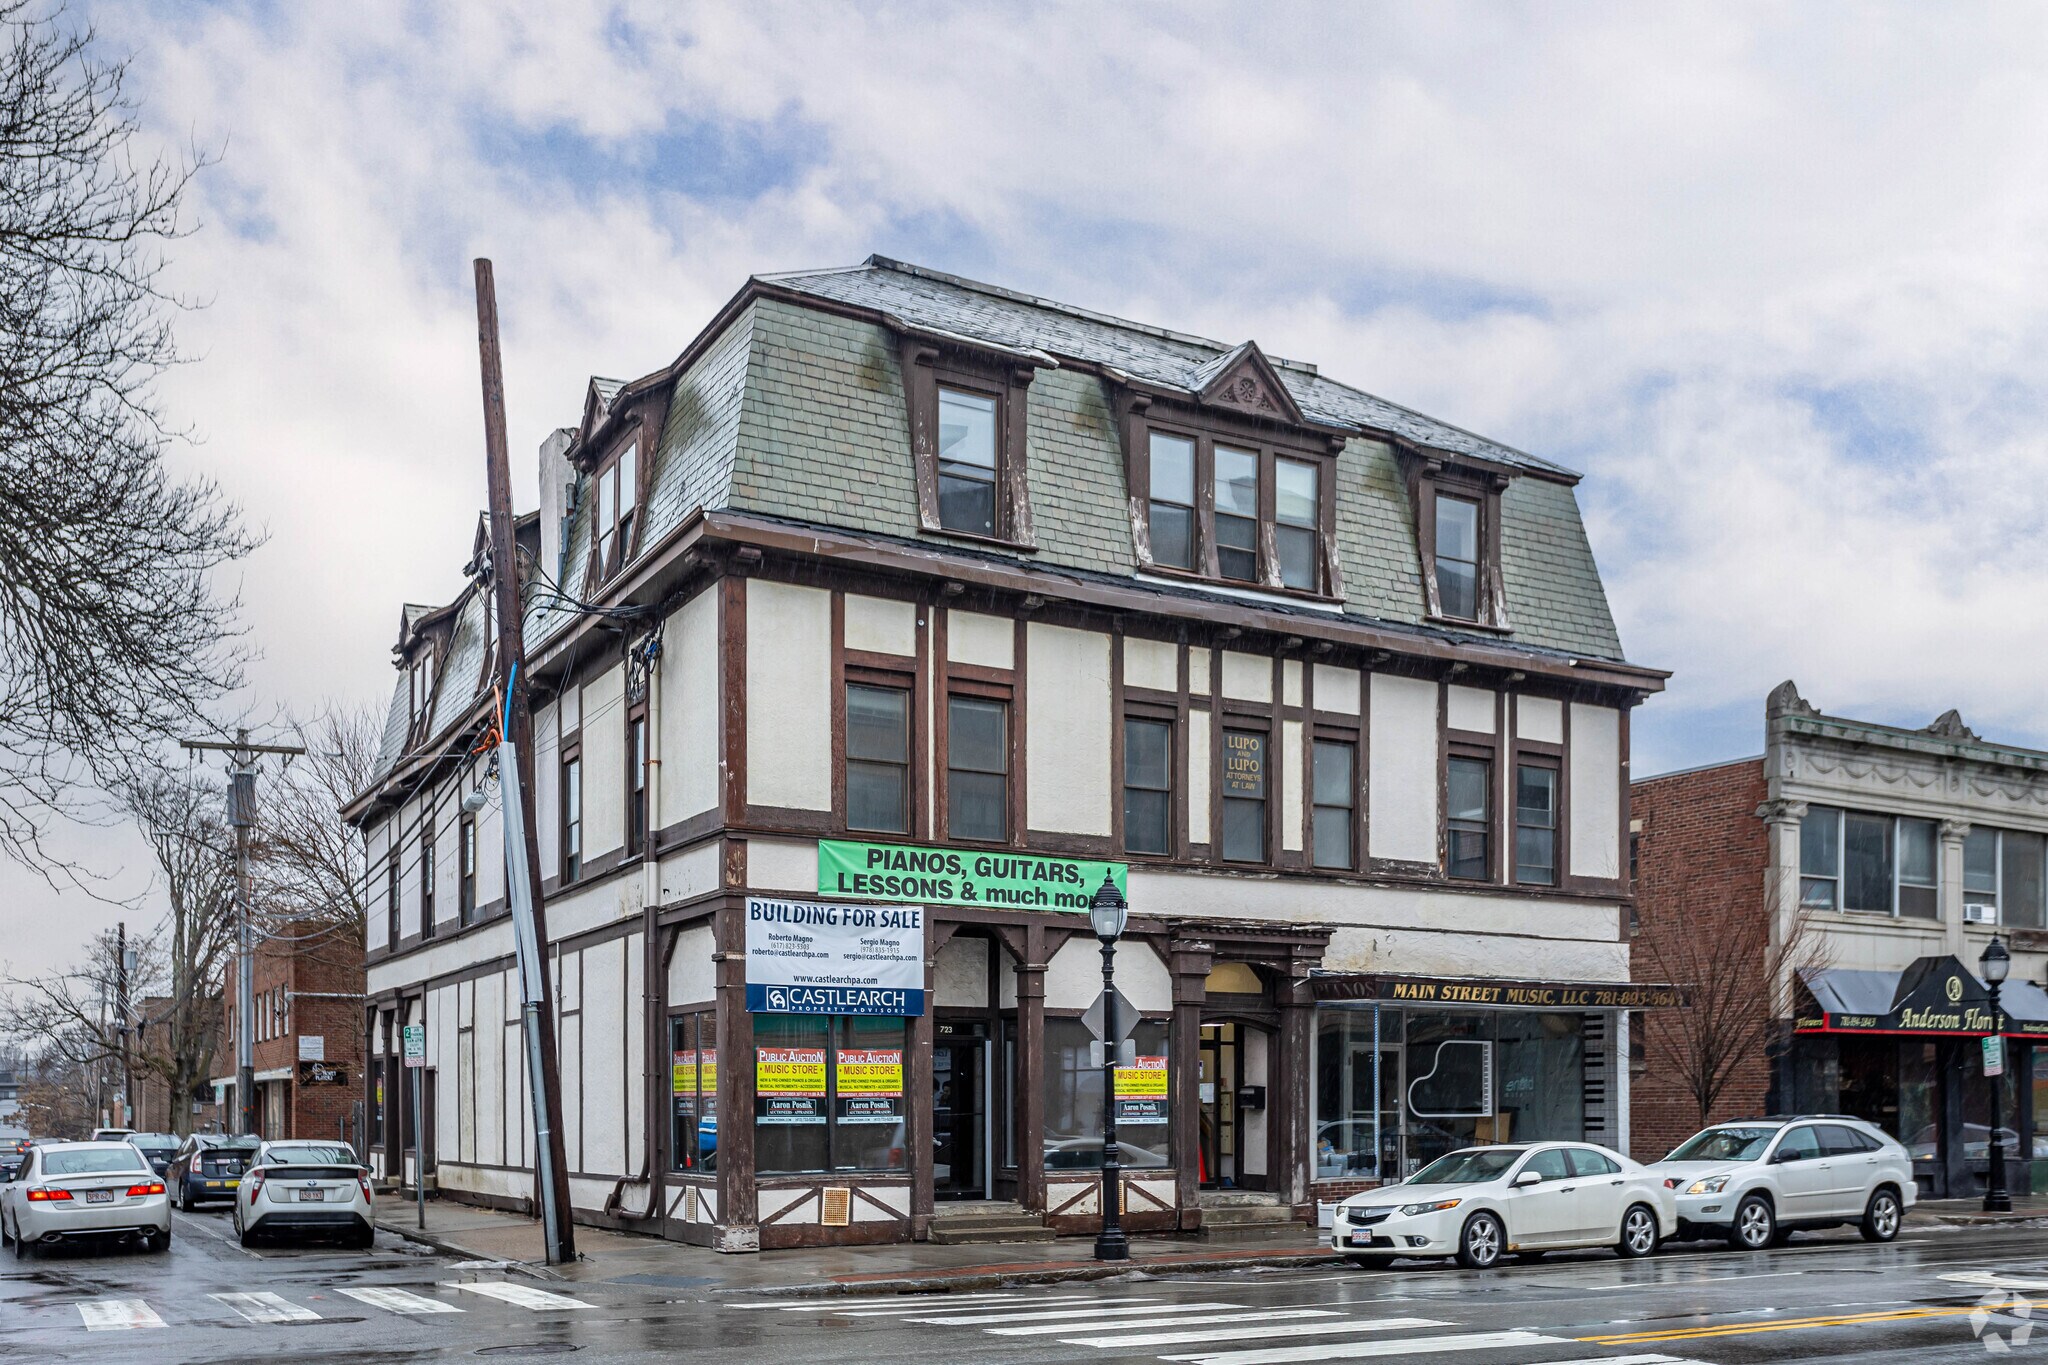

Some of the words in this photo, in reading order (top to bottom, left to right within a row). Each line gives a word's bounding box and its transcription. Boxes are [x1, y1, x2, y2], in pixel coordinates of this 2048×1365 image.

[1228, 735, 1259, 751] LUPO
[1228, 757, 1259, 772] LUPO
[1226, 771, 1262, 782] ATTORNEYS
[1231, 781, 1240, 789] AT
[1241, 782, 1256, 790] LAW
[867, 848, 968, 879] PIANOS,
[974, 856, 1086, 888] GUITARS,
[838, 872, 954, 900] LESSONS
[960, 882, 978, 902] &
[986, 885, 1048, 906] much
[750, 901, 838, 926] BUILDING
[842, 908, 876, 928] FOR
[880, 910, 921, 929] SALE
[768, 933, 792, 942] Roberto
[793, 934, 813, 944] Magno
[860, 937, 879, 947] Sergio
[880, 938, 900, 948] Magno
[770, 941, 785, 949] (617)
[752, 948, 829, 959] roberto@castlearchpa.com
[843, 952, 917, 962] sergio@castlearchpa.com
[793, 974, 878, 985] www.castlearchpa.com
[790, 988, 906, 1007] CASTLEARCH
[1392, 983, 1436, 1000] MAIN
[1440, 985, 1502, 1002] STREET
[1505, 988, 1557, 1005] MUSIC,
[1561, 990, 1590, 1004] LLC
[1898, 1006, 1960, 1030] Anderson
[1962, 1007, 2005, 1031] Florit
[405, 1028, 410, 1037] 2
[939, 1025, 953, 1034] 723
[759, 1050, 787, 1062] PUBLIC
[788, 1050, 823, 1063] AUCTION
[838, 1052, 865, 1064] PUBLIC
[866, 1052, 900, 1064] AUCTION
[764, 1064, 790, 1074] MUSIC
[791, 1065, 818, 1074] STORE
[843, 1066, 868, 1075] MUSIC
[869, 1066, 895, 1075] STORE
[1117, 1071, 1138, 1079] MUSIC
[1139, 1071, 1161, 1079] STORE
[771, 1101, 790, 1109] Aaron
[792, 1100, 813, 1109] Posnik
[850, 1101, 869, 1109] Aaron
[870, 1100, 890, 1109] Posnik
[1140, 1103, 1157, 1111] Posnik
